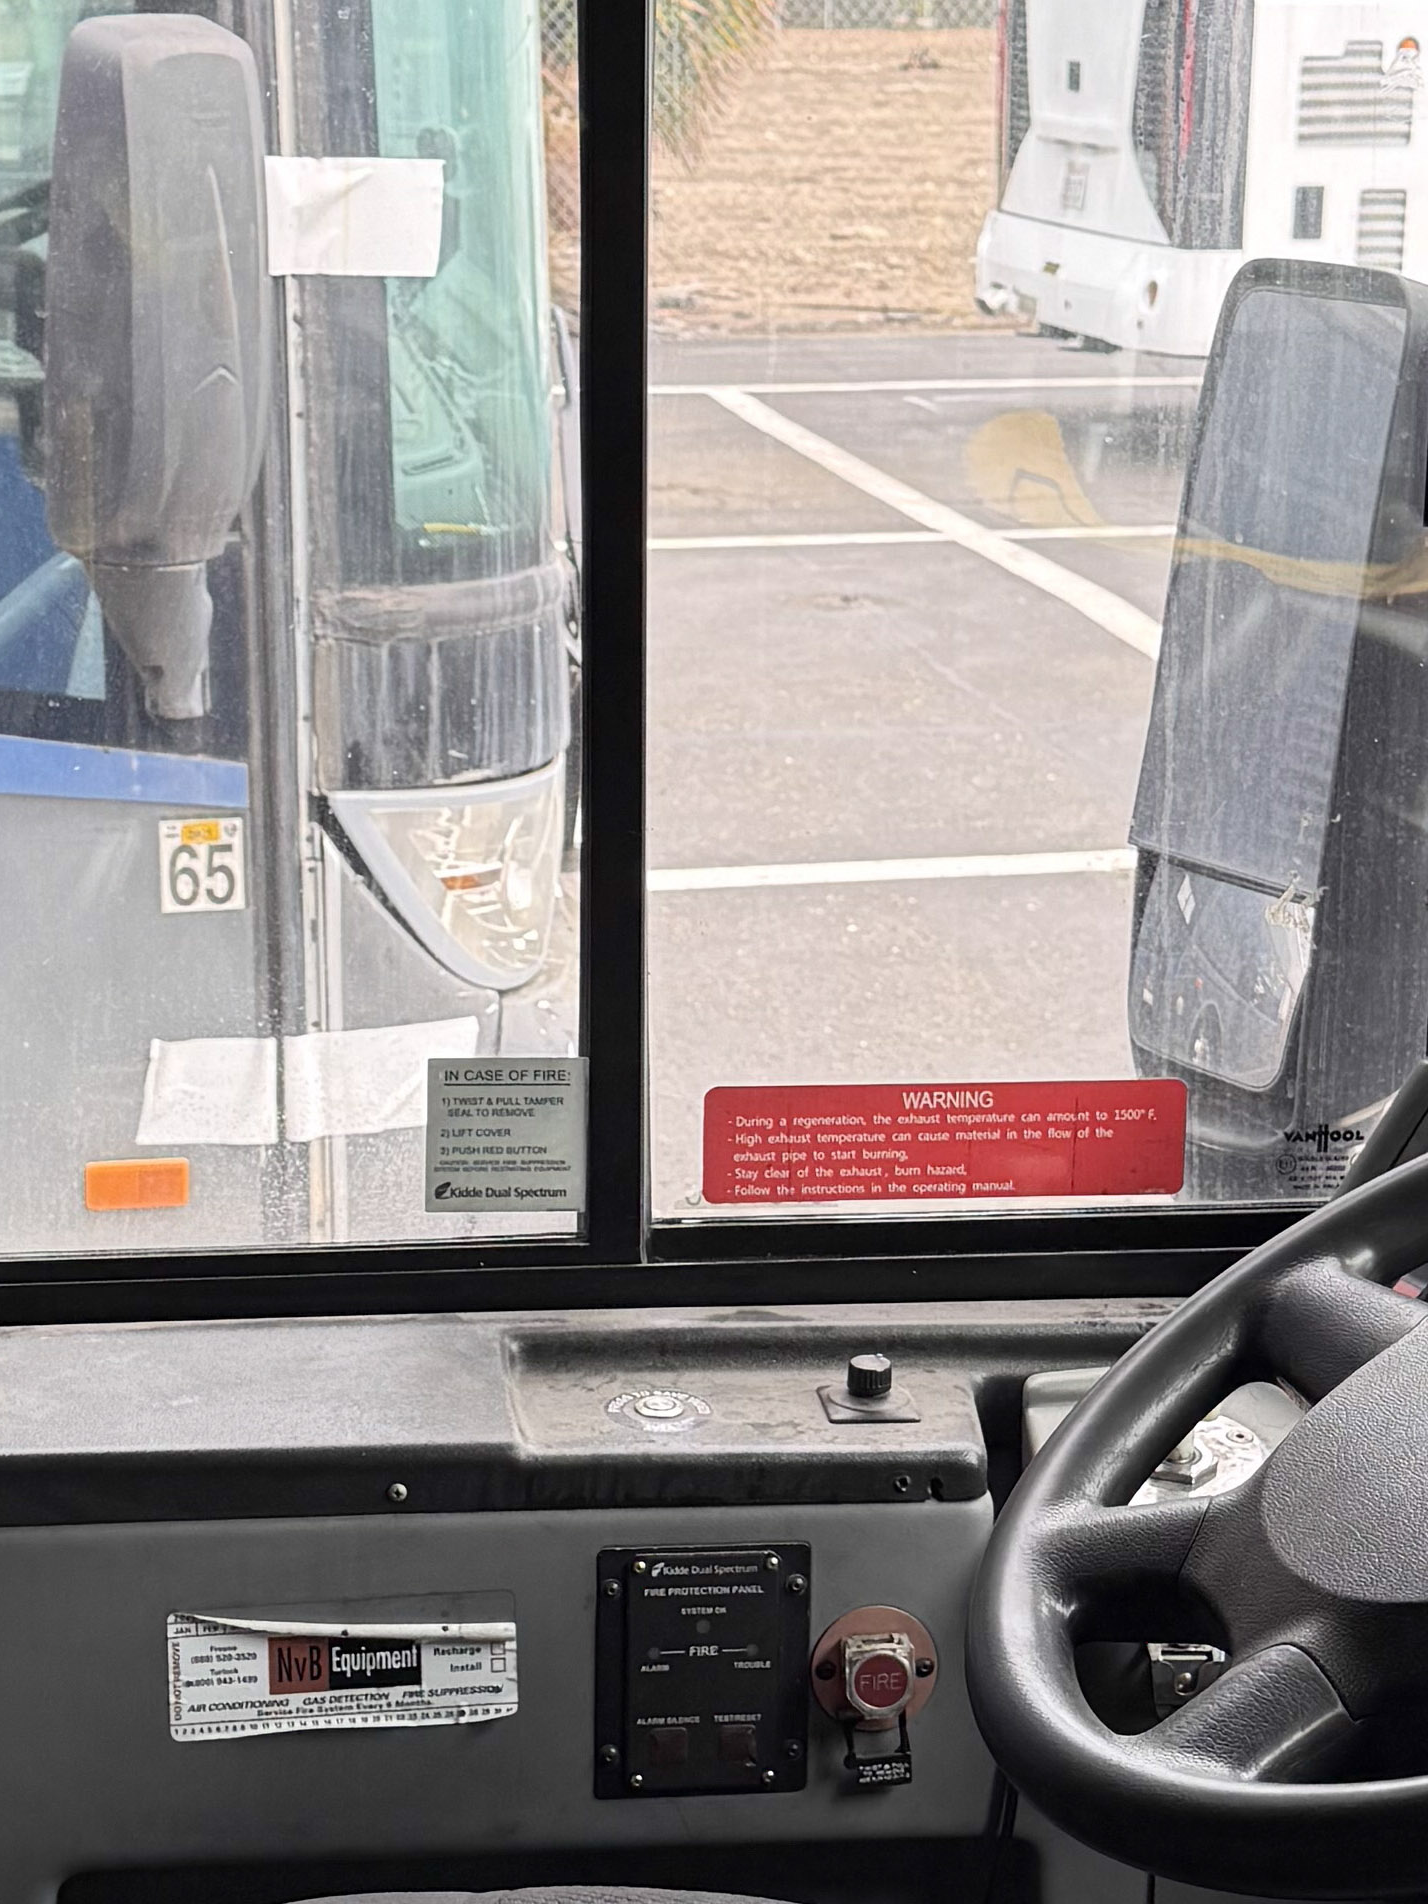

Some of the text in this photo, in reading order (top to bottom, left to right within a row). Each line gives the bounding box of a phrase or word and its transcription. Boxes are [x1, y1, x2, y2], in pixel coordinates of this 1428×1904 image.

[170, 844, 235, 906] 65
[444, 1070, 571, 1081] IN CASE OF FIRE:
[496, 1097, 520, 1105] PULL
[524, 1097, 564, 1105] TAMPER
[902, 1091, 994, 1109] WARNING
[448, 1109, 535, 1117] SEAL TO REMOVE
[736, 1116, 773, 1130] During
[779, 1118, 787, 1127] a
[873, 1114, 892, 1125] the
[897, 1114, 940, 1125] exhaust
[947, 1113, 1015, 1124] temperature
[1021, 1113, 1041, 1122] can
[1047, 1112, 1089, 1122] amount
[1096, 1111, 1108, 1121] to
[441, 1129, 450, 1138] 2)
[476, 1129, 511, 1137] COVER
[736, 1127, 1114, 1147] High exhaust temperature can cause material in the flow of the
[733, 1151, 776, 1162] exhaust
[781, 1150, 807, 1163] pipe
[813, 1151, 825, 1161] to
[831, 1150, 856, 1160] start
[735, 1168, 758, 1180] Stay
[764, 1168, 790, 1178] clear
[797, 1167, 809, 1178] of
[815, 1167, 834, 1177] the
[894, 1166, 921, 1176] burn
[450, 1187, 567, 1200] Kidde Dual Spectrum
[735, 1182, 966, 1196] Follow the instructions in the operating
[663, 1565, 757, 1576] Kidde Dual Spectrum
[644, 1585, 764, 1596] FIRE PROTECTION PANEL
[681, 1607, 713, 1615] SYSTEM
[174, 1626, 191, 1634] JAN
[434, 1647, 481, 1656] Recharge
[689, 1646, 718, 1656] FIRE
[277, 1645, 417, 1683] NvB Equipment
[450, 1662, 482, 1672] Install
[734, 1661, 771, 1669] TROUBLE
[860, 1672, 902, 1692] FIRE
[187, 1704, 206, 1712] AIR
[208, 1698, 289, 1711] CONDITIONING
[303, 1696, 326, 1706] GAS
[329, 1692, 390, 1704] DETECTION
[403, 1690, 426, 1698] FIRE
